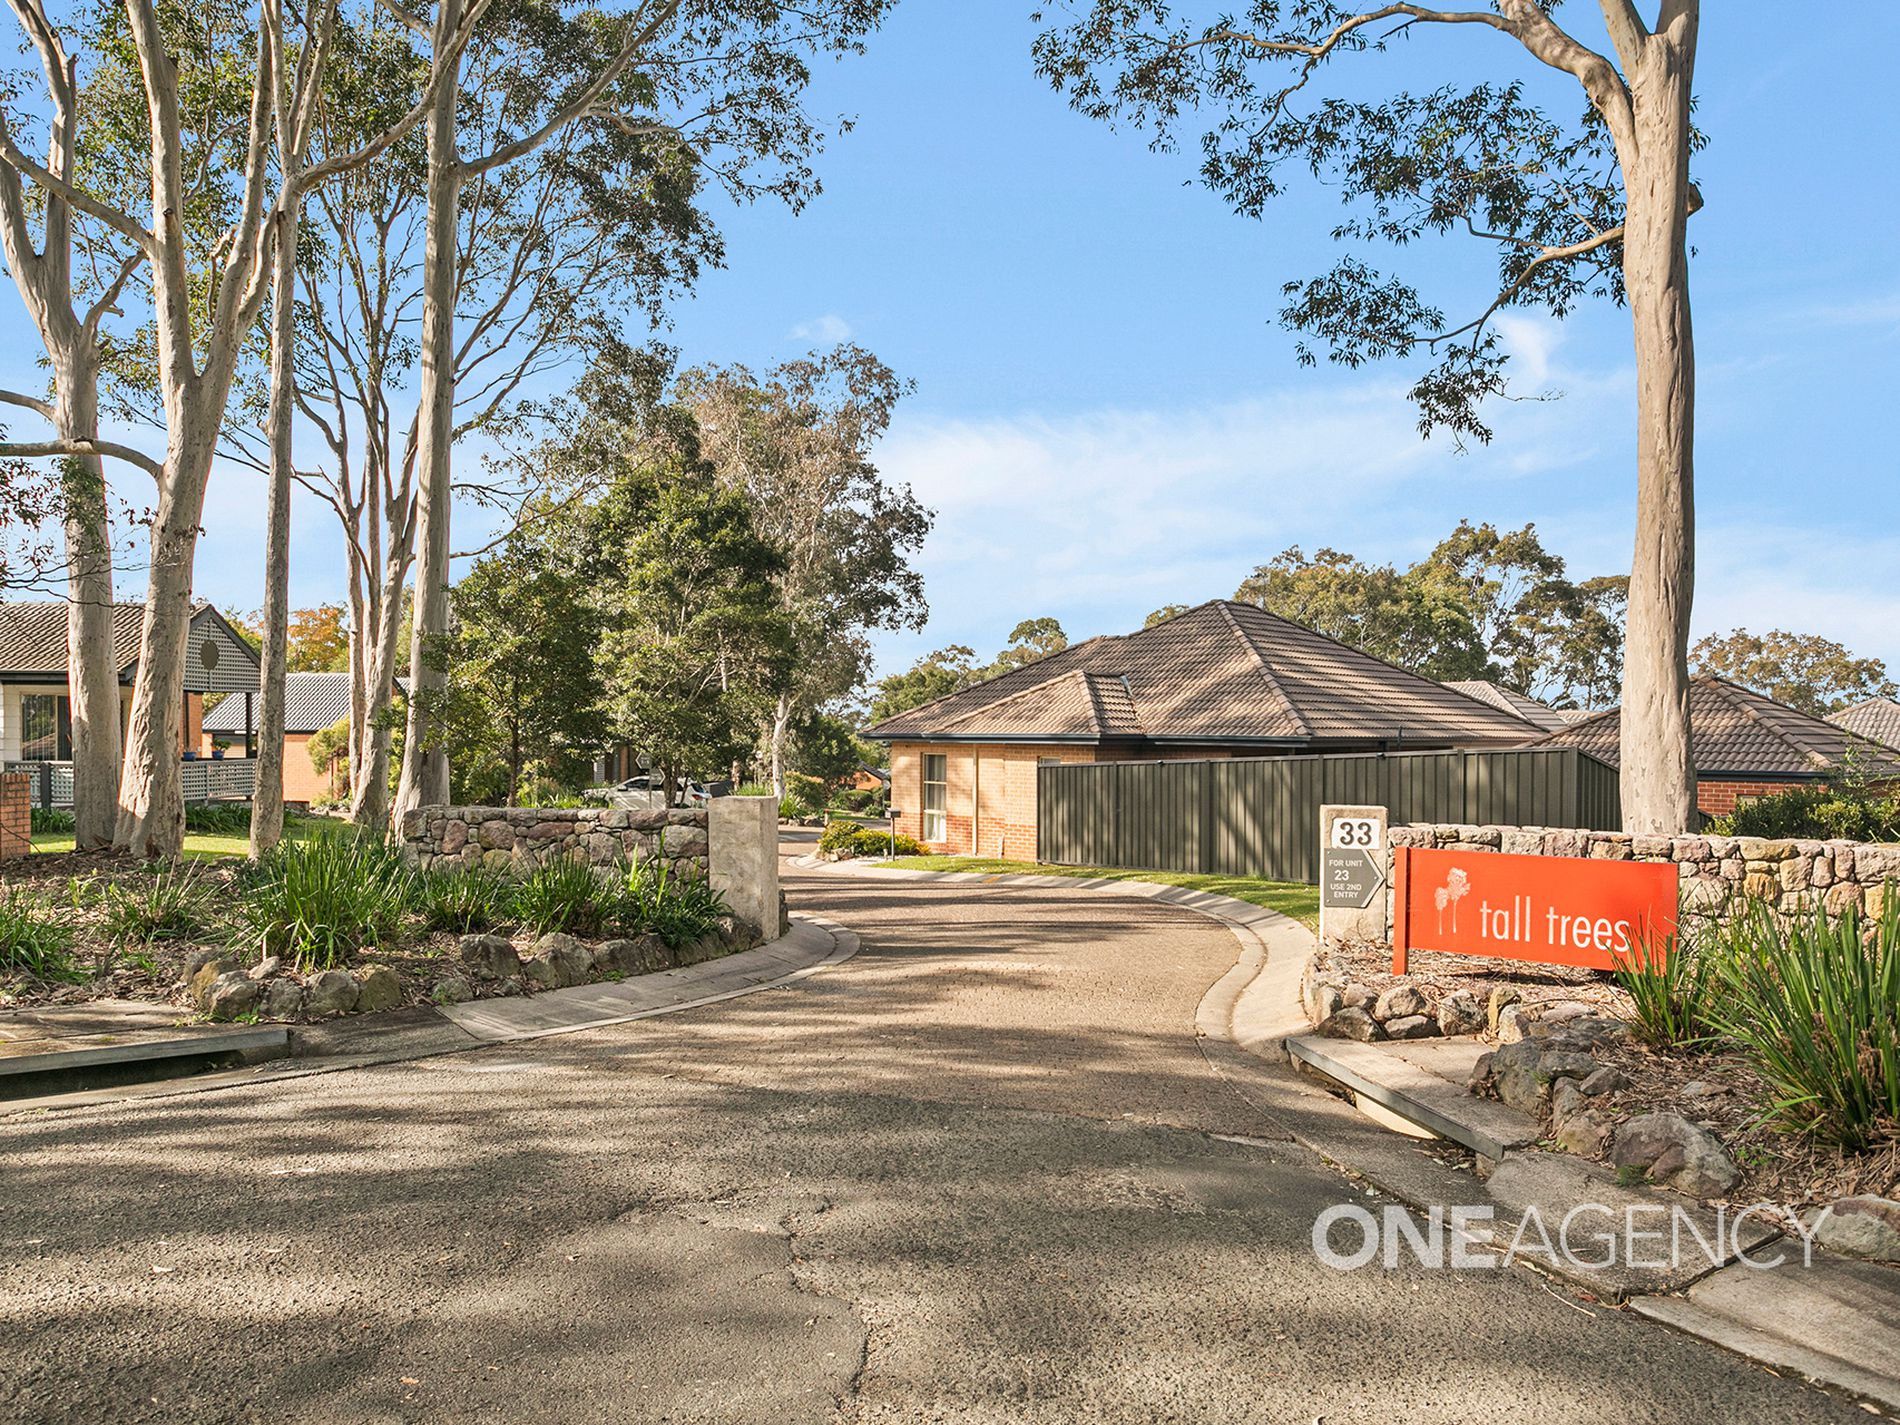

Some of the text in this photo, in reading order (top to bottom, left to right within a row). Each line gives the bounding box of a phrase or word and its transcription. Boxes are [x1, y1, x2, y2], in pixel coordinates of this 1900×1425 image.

[1340, 822, 1372, 845] 33
[1334, 870, 1349, 880] 23
[1479, 895, 1631, 952] tall trees
